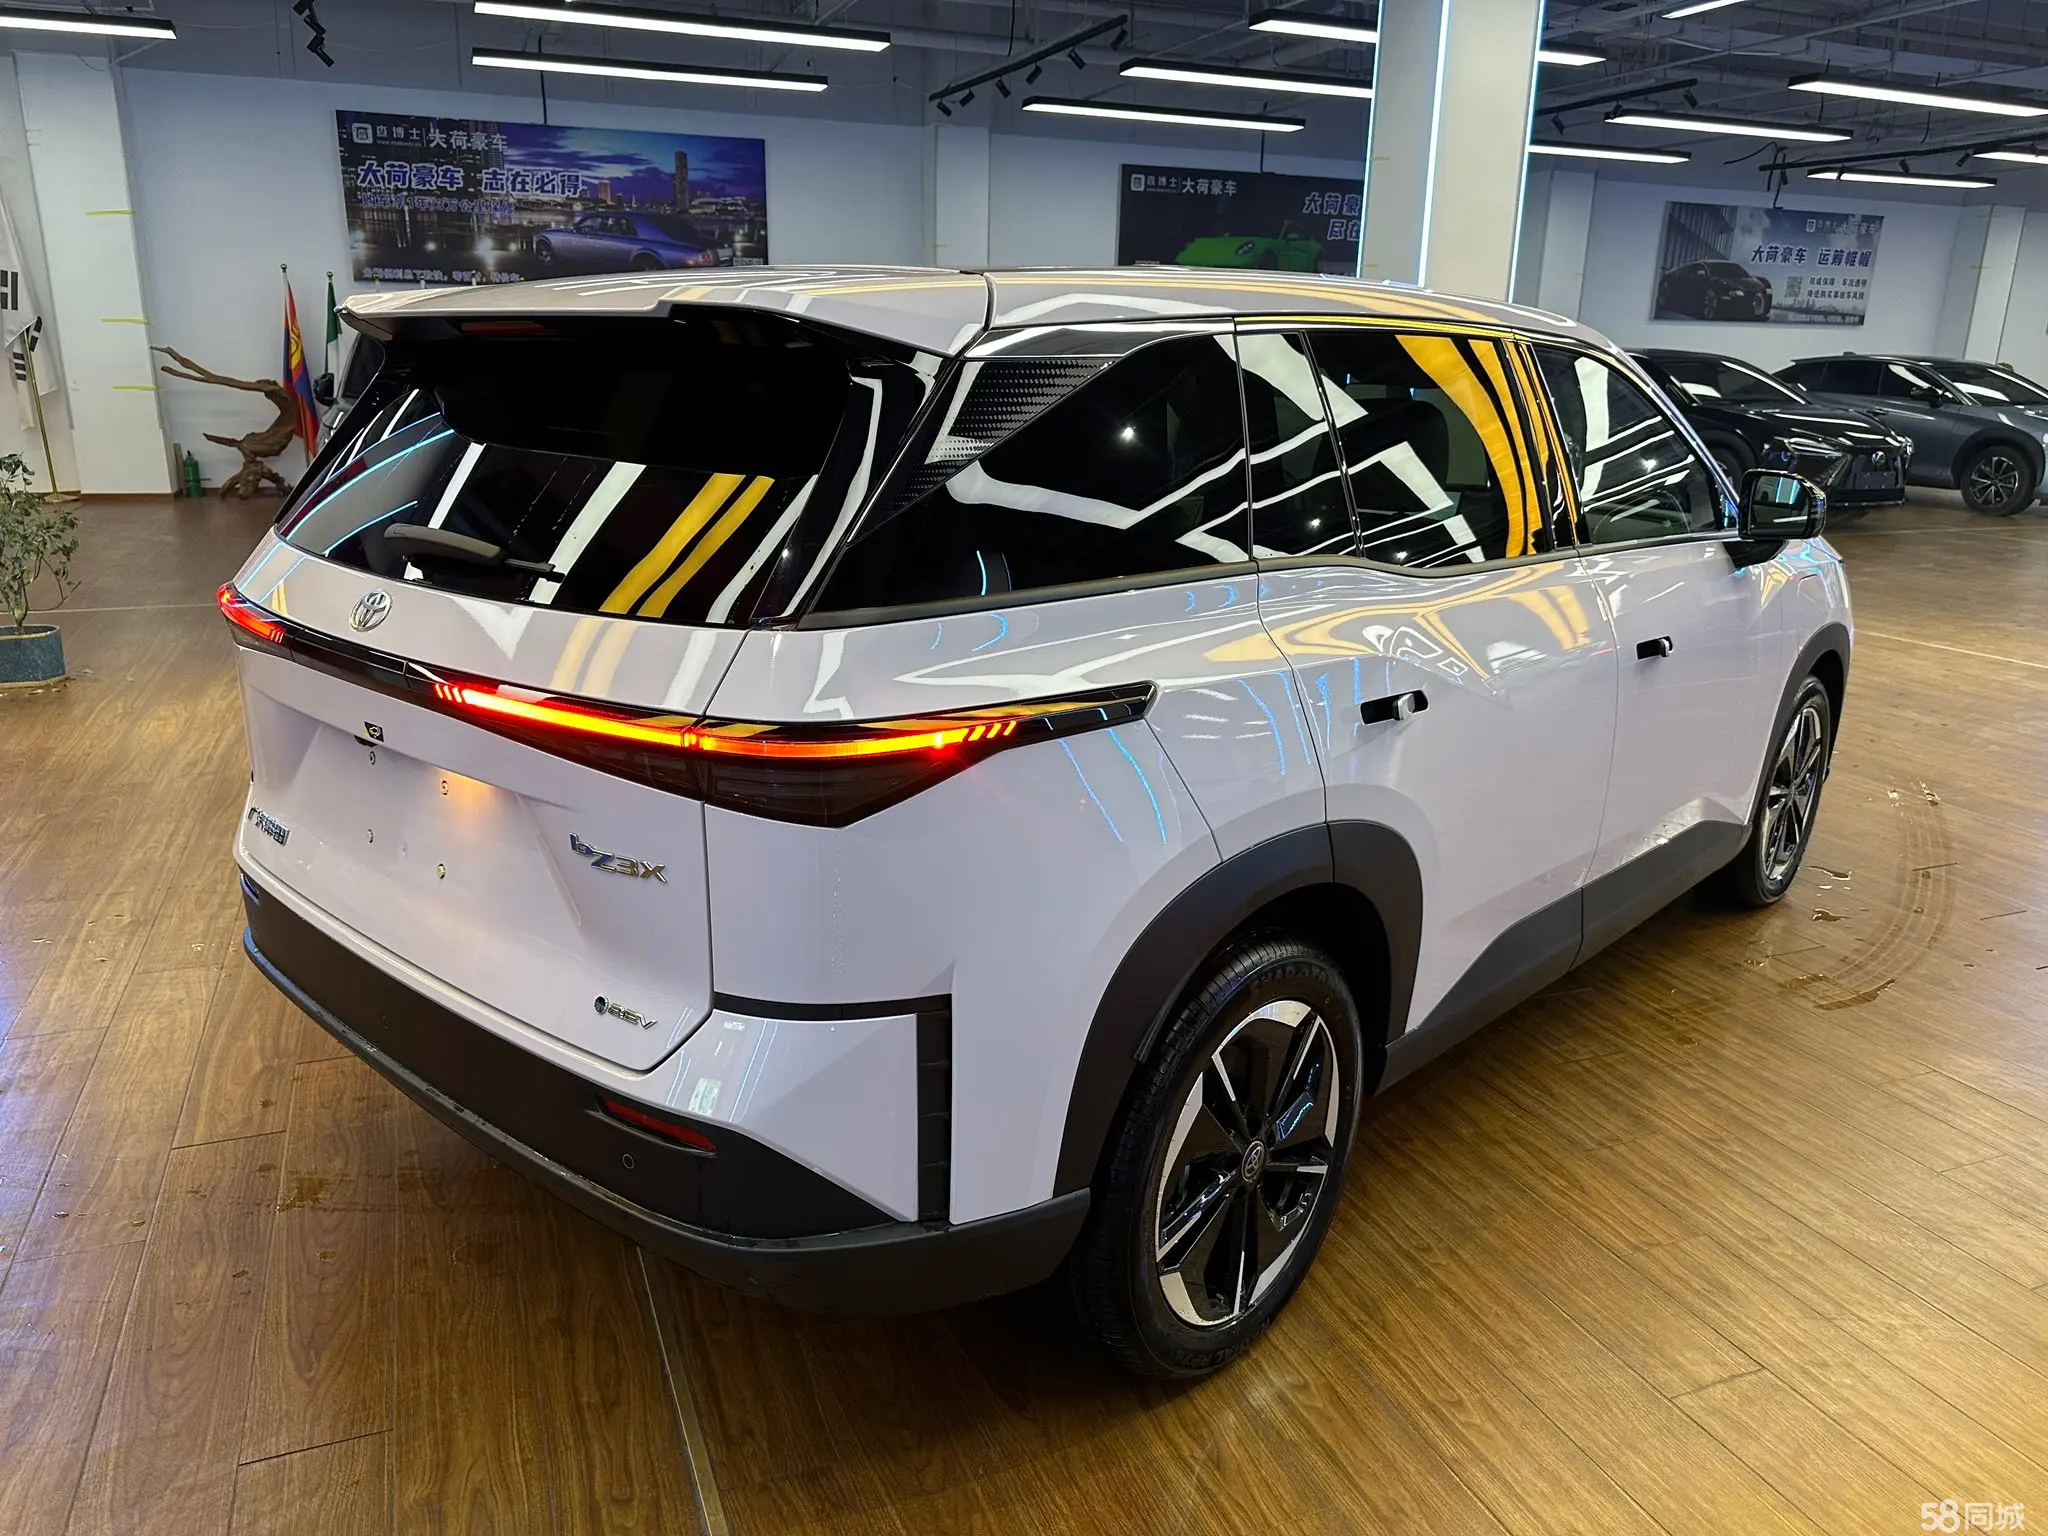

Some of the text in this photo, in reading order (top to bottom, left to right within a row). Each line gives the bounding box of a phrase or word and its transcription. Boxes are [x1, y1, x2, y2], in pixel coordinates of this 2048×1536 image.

[429, 129, 508, 151] 大荷豪车
[358, 160, 581, 198] 大荷豪车 志在必得
[1182, 177, 1237, 197] 大荷豪车
[1303, 192, 1361, 216] 大荷豪
[1750, 244, 1873, 268] 大荷豪车 运筹帷幄
